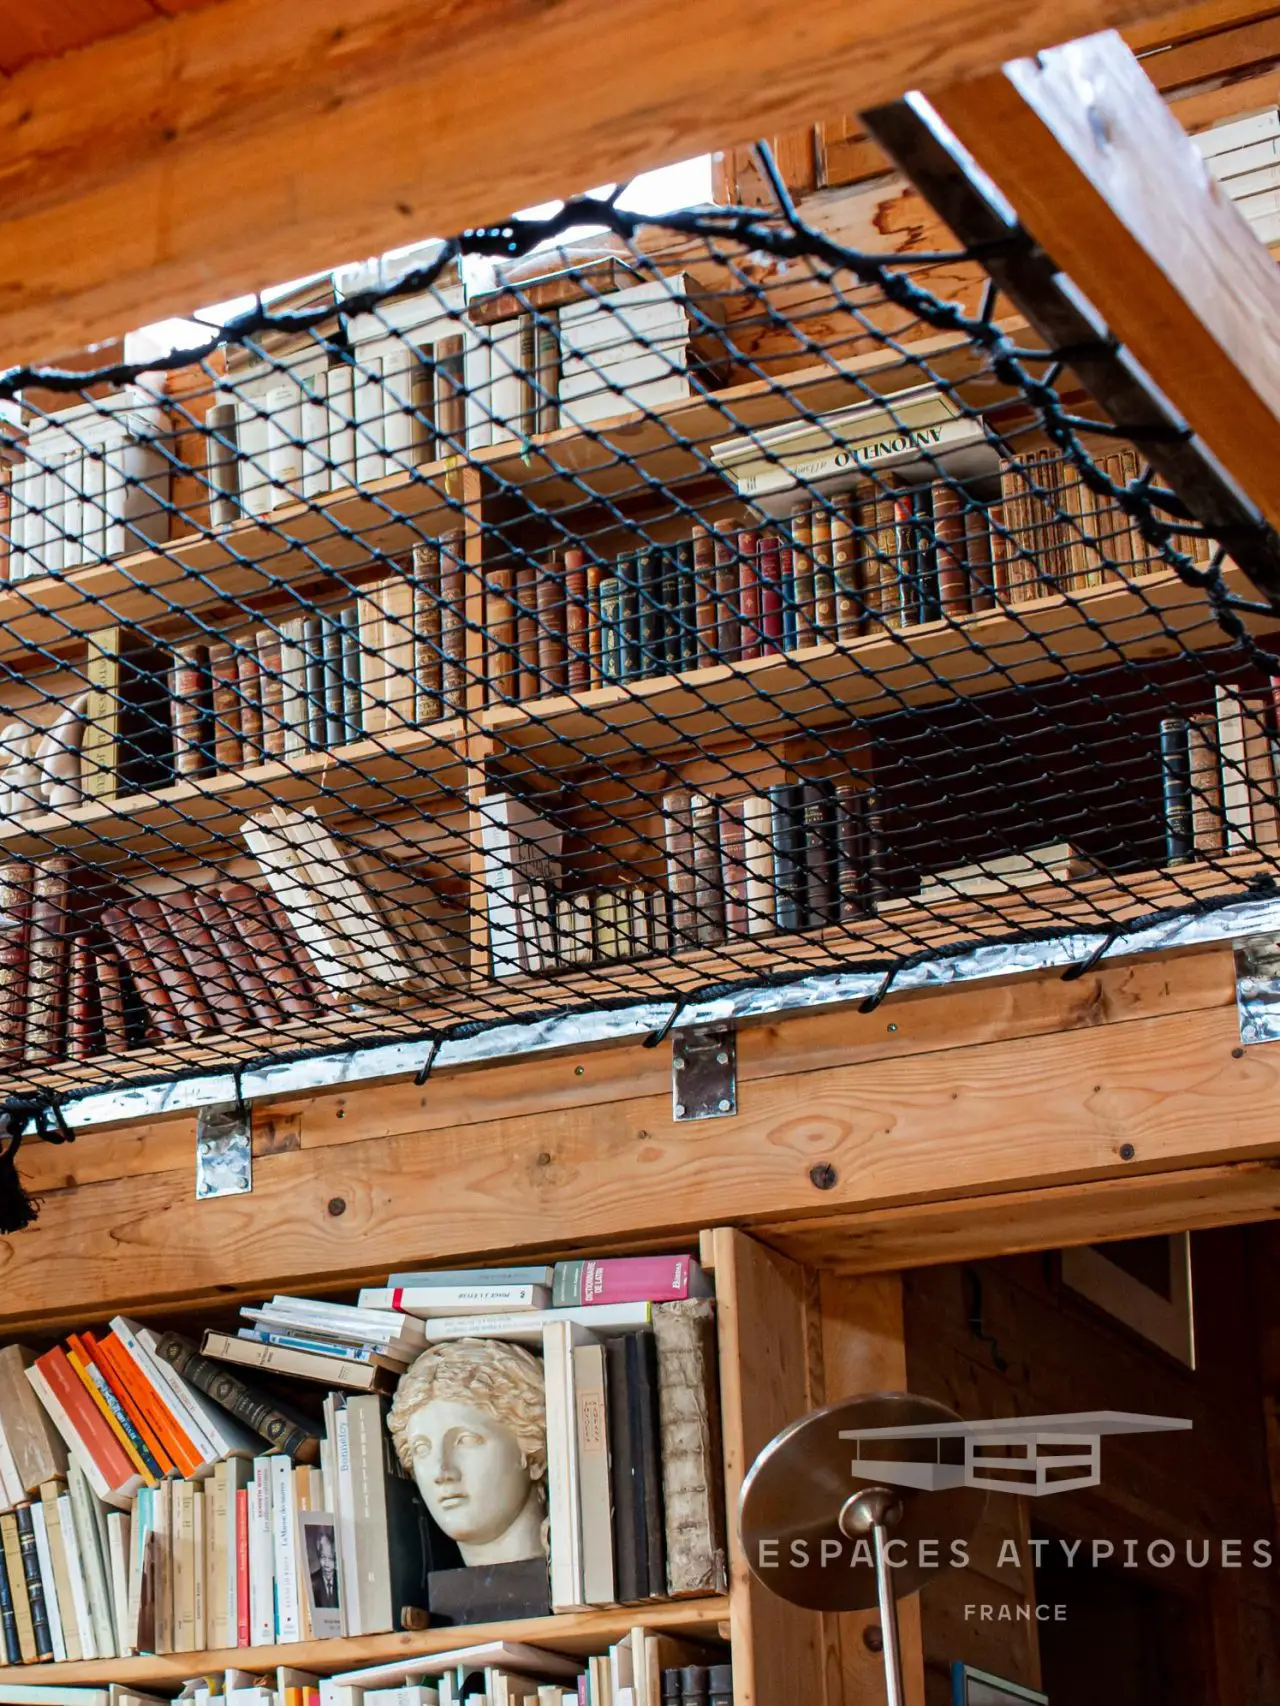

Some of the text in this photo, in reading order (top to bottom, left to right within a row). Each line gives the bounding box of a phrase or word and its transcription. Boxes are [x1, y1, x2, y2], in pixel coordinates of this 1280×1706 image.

[595, 1267, 604, 1294] DE LATIN
[338, 1422, 349, 1471] Bonnefoy
